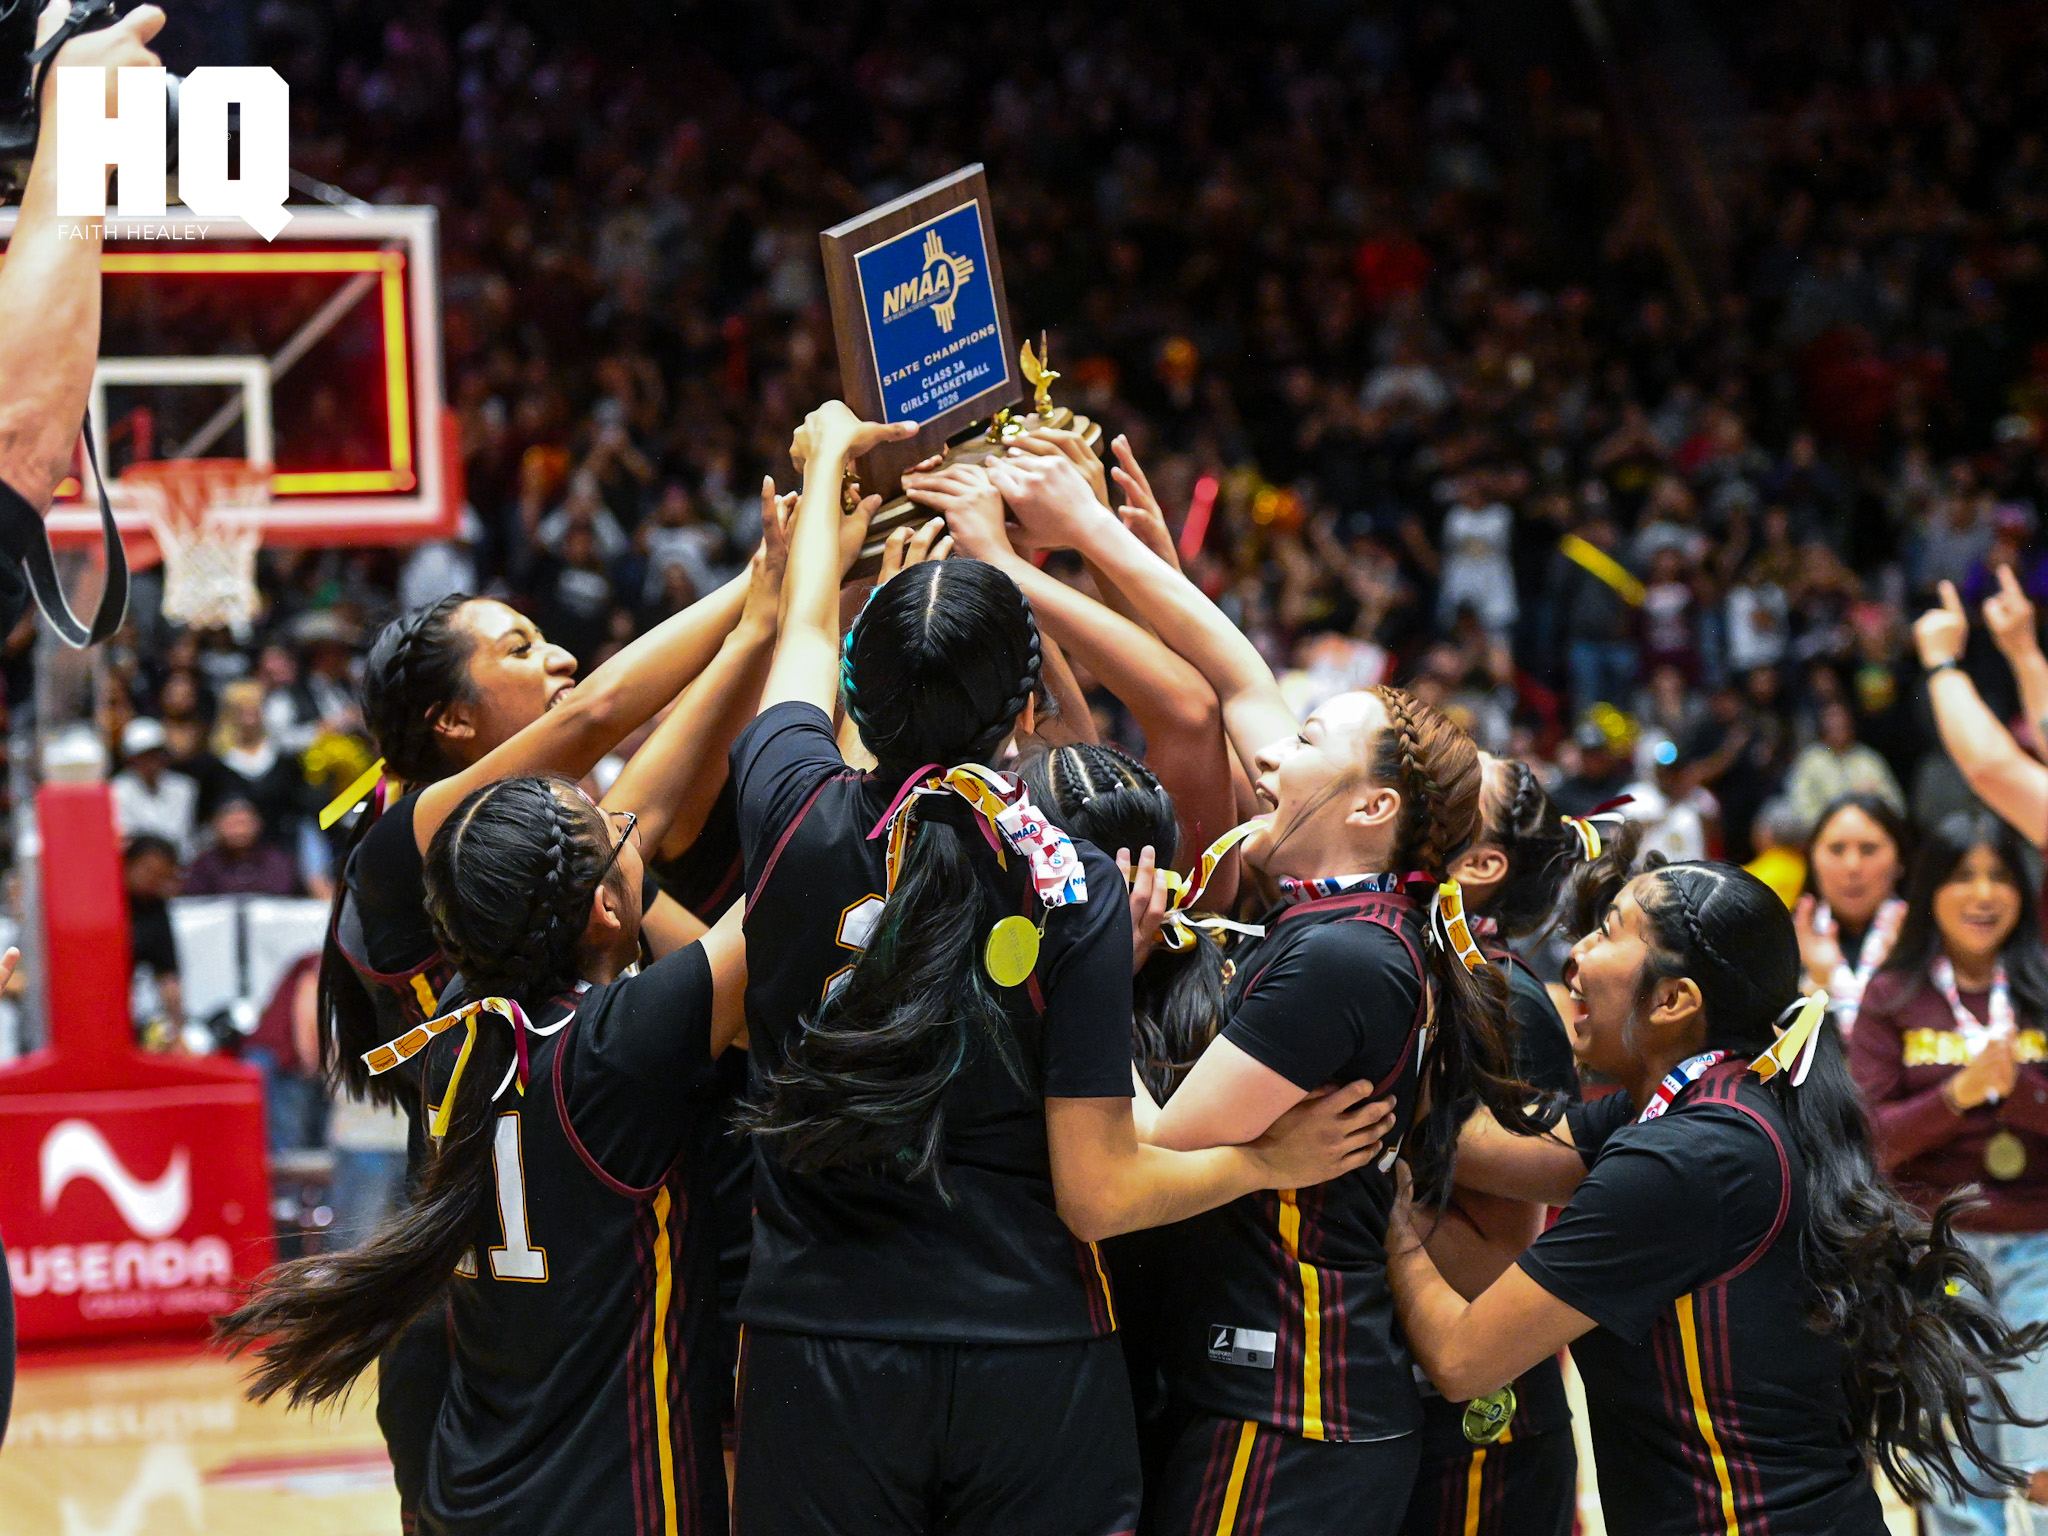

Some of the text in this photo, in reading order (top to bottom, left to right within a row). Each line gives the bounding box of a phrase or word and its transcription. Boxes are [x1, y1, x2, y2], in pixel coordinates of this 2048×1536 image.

[883, 263, 950, 317] NMAA
[882, 323, 996, 386] STATE CHAMPIONS
[921, 359, 966, 389] CLASS 3A
[900, 361, 991, 414] GIRLS BASKETBALL
[937, 391, 959, 411] 2026
